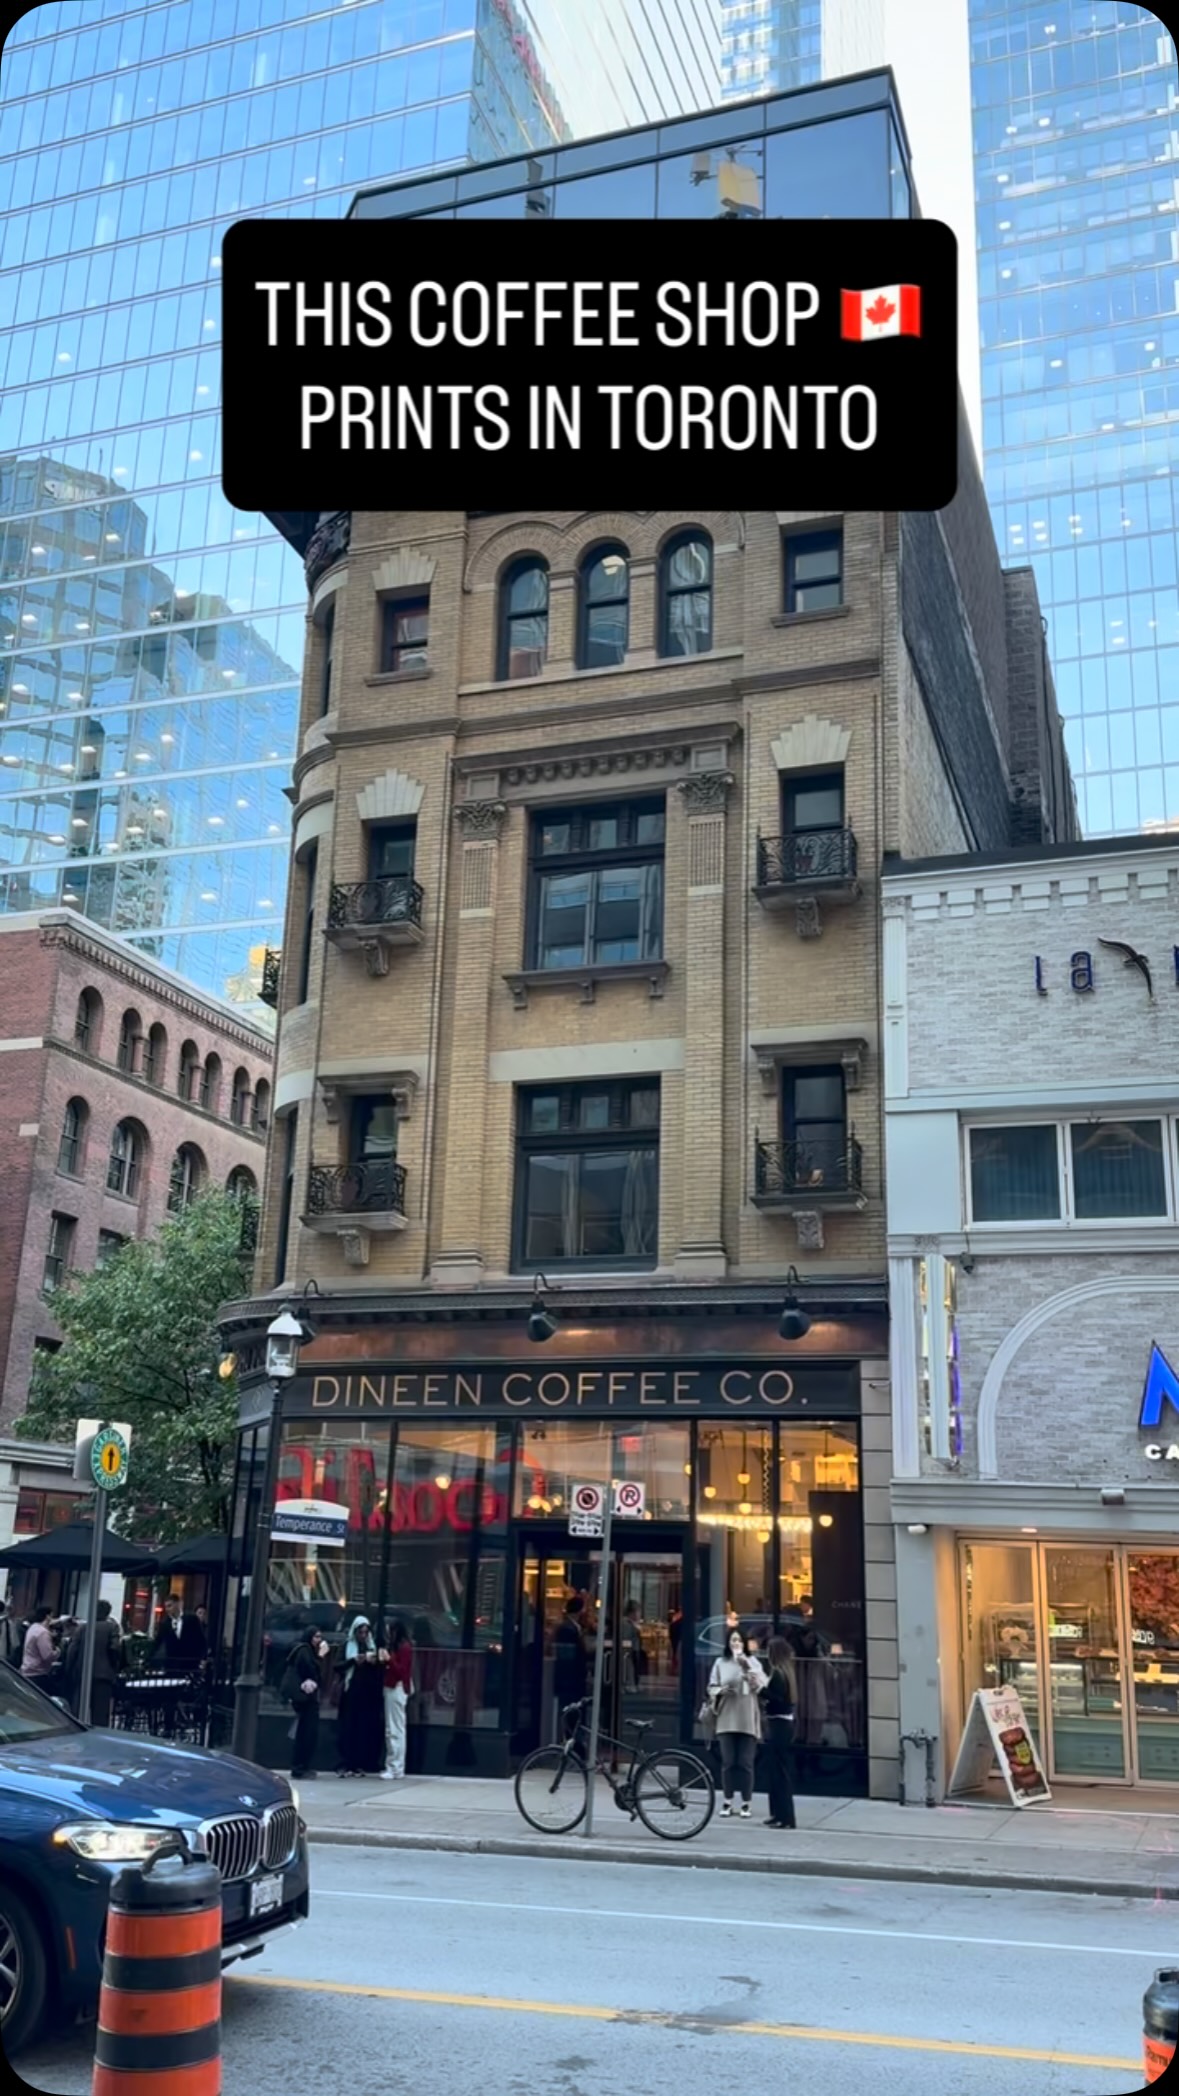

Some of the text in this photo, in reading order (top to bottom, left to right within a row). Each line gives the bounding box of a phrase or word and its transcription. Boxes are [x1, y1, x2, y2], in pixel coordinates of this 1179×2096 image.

[312, 1371, 808, 1407] DINEEN COFFEE CO.
[276, 1515, 333, 1533] Temperance
